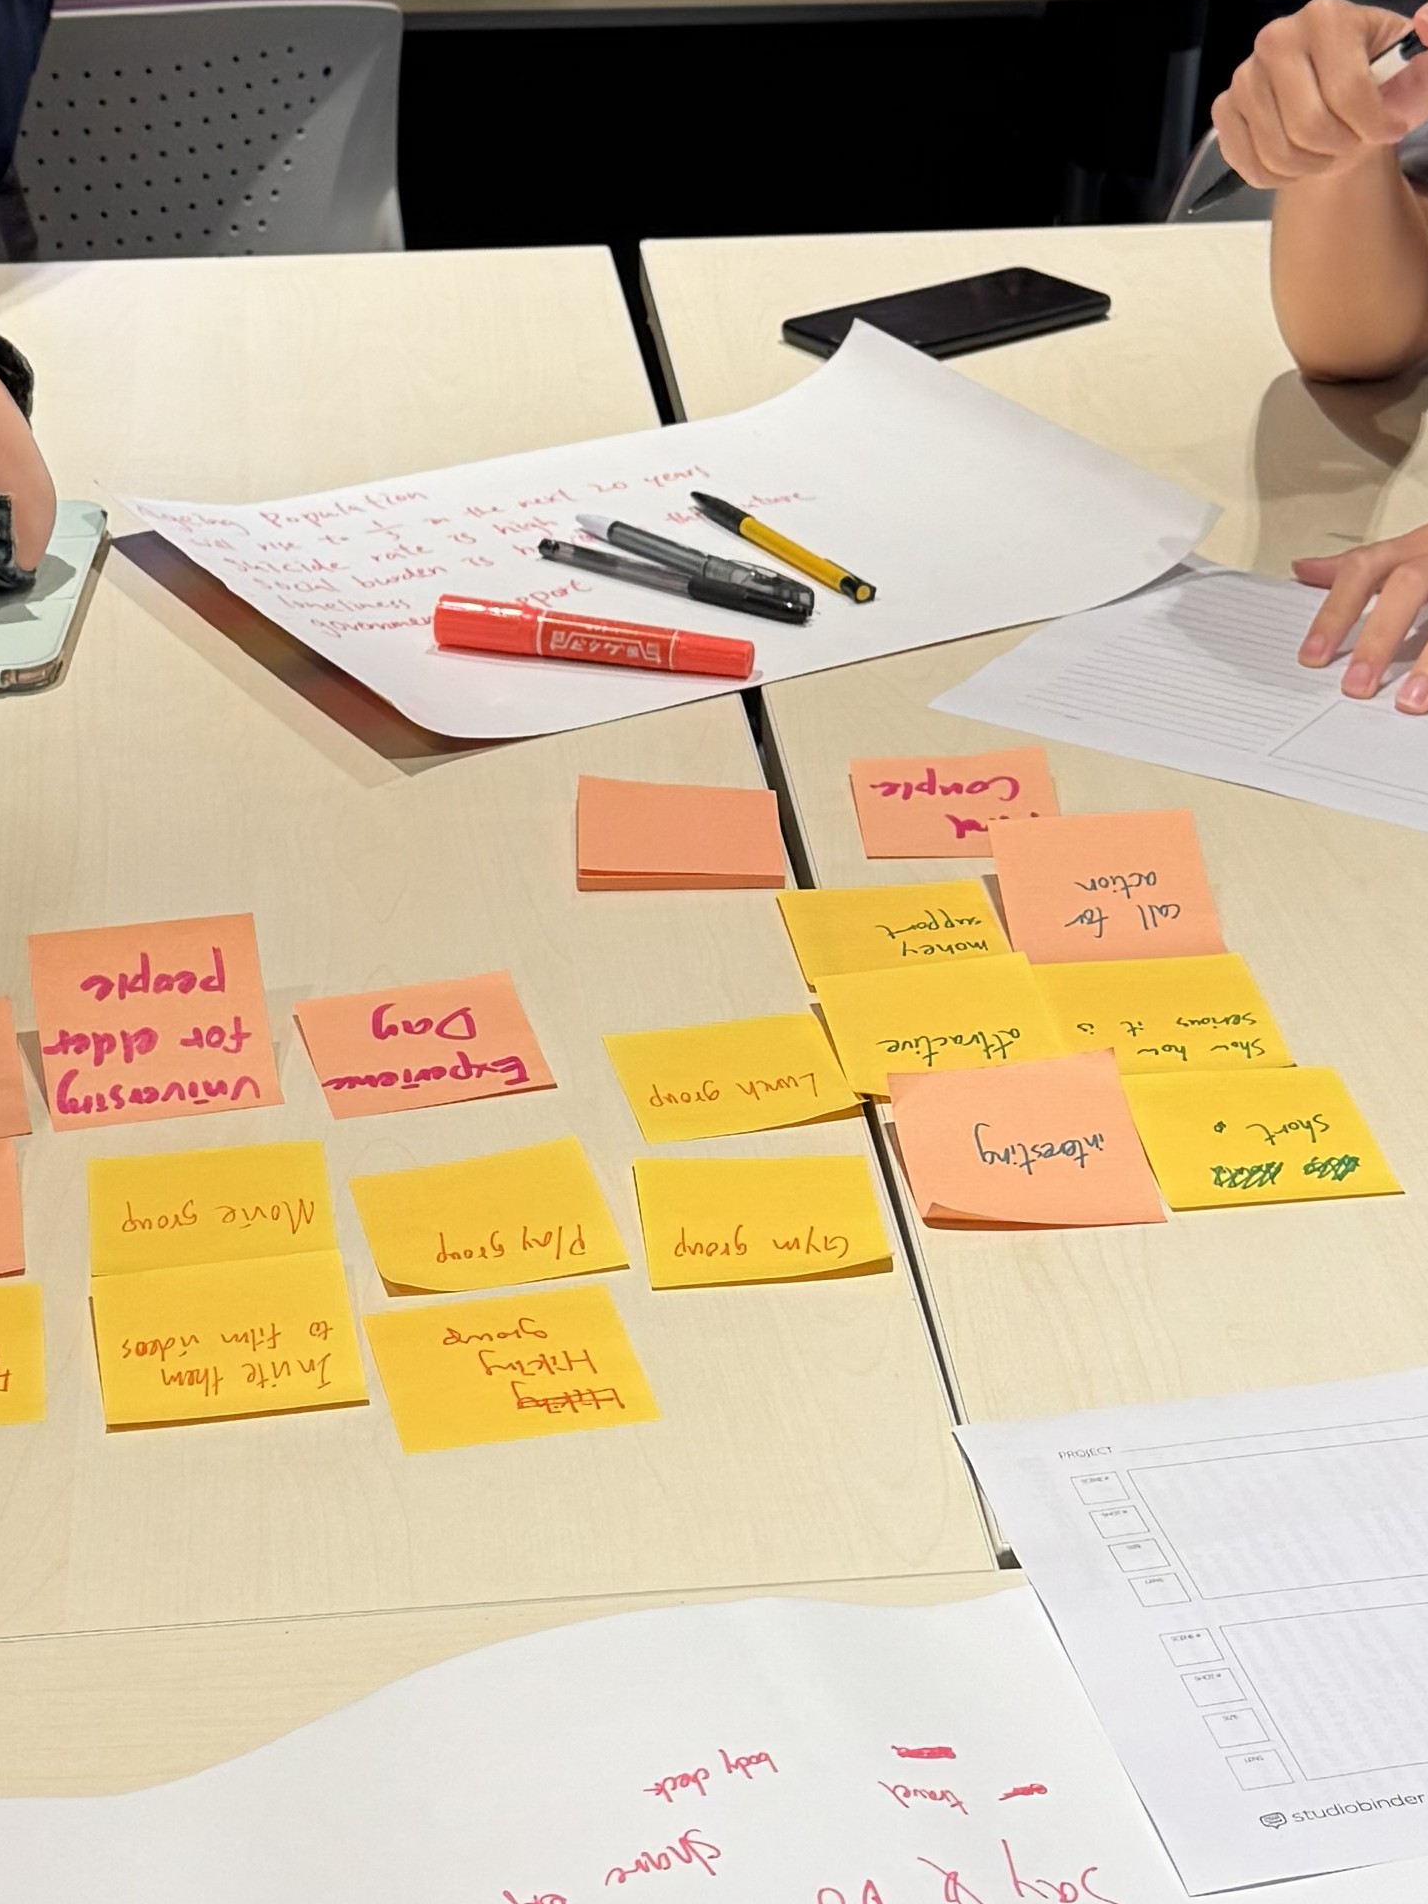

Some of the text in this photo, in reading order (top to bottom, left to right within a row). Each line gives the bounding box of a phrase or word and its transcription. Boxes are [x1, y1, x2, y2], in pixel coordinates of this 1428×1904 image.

[870, 767, 1021, 803] Couple
[1074, 871, 1158, 899] action
[875, 908, 983, 938] support
[1063, 903, 1181, 938] call for
[902, 938, 989, 958] money
[80, 946, 226, 1002] people
[370, 1003, 478, 1042] Day
[1076, 1011, 1258, 1037] serious it is
[42, 1016, 251, 1067] for elder
[876, 1026, 1022, 1067] attractive
[1136, 1043, 1188, 1063] how
[648, 1071, 819, 1110] Lunch group
[1245, 1113, 1330, 1148] short
[975, 1122, 1106, 1176] interesting
[121, 1198, 316, 1235] Movie group
[434, 1224, 588, 1267] Play group
[672, 1224, 850, 1261] Gym group
[121, 1320, 335, 1361] to film videos
[441, 1317, 548, 1349] group
[159, 1352, 333, 1397] Invite them
[478, 1349, 598, 1378] Hiking
[1058, 1446, 1113, 1459] PROJECT
[718, 1749, 778, 1781] body
[877, 1779, 969, 1816] travel
[1291, 1791, 1426, 1825] studiobinder
